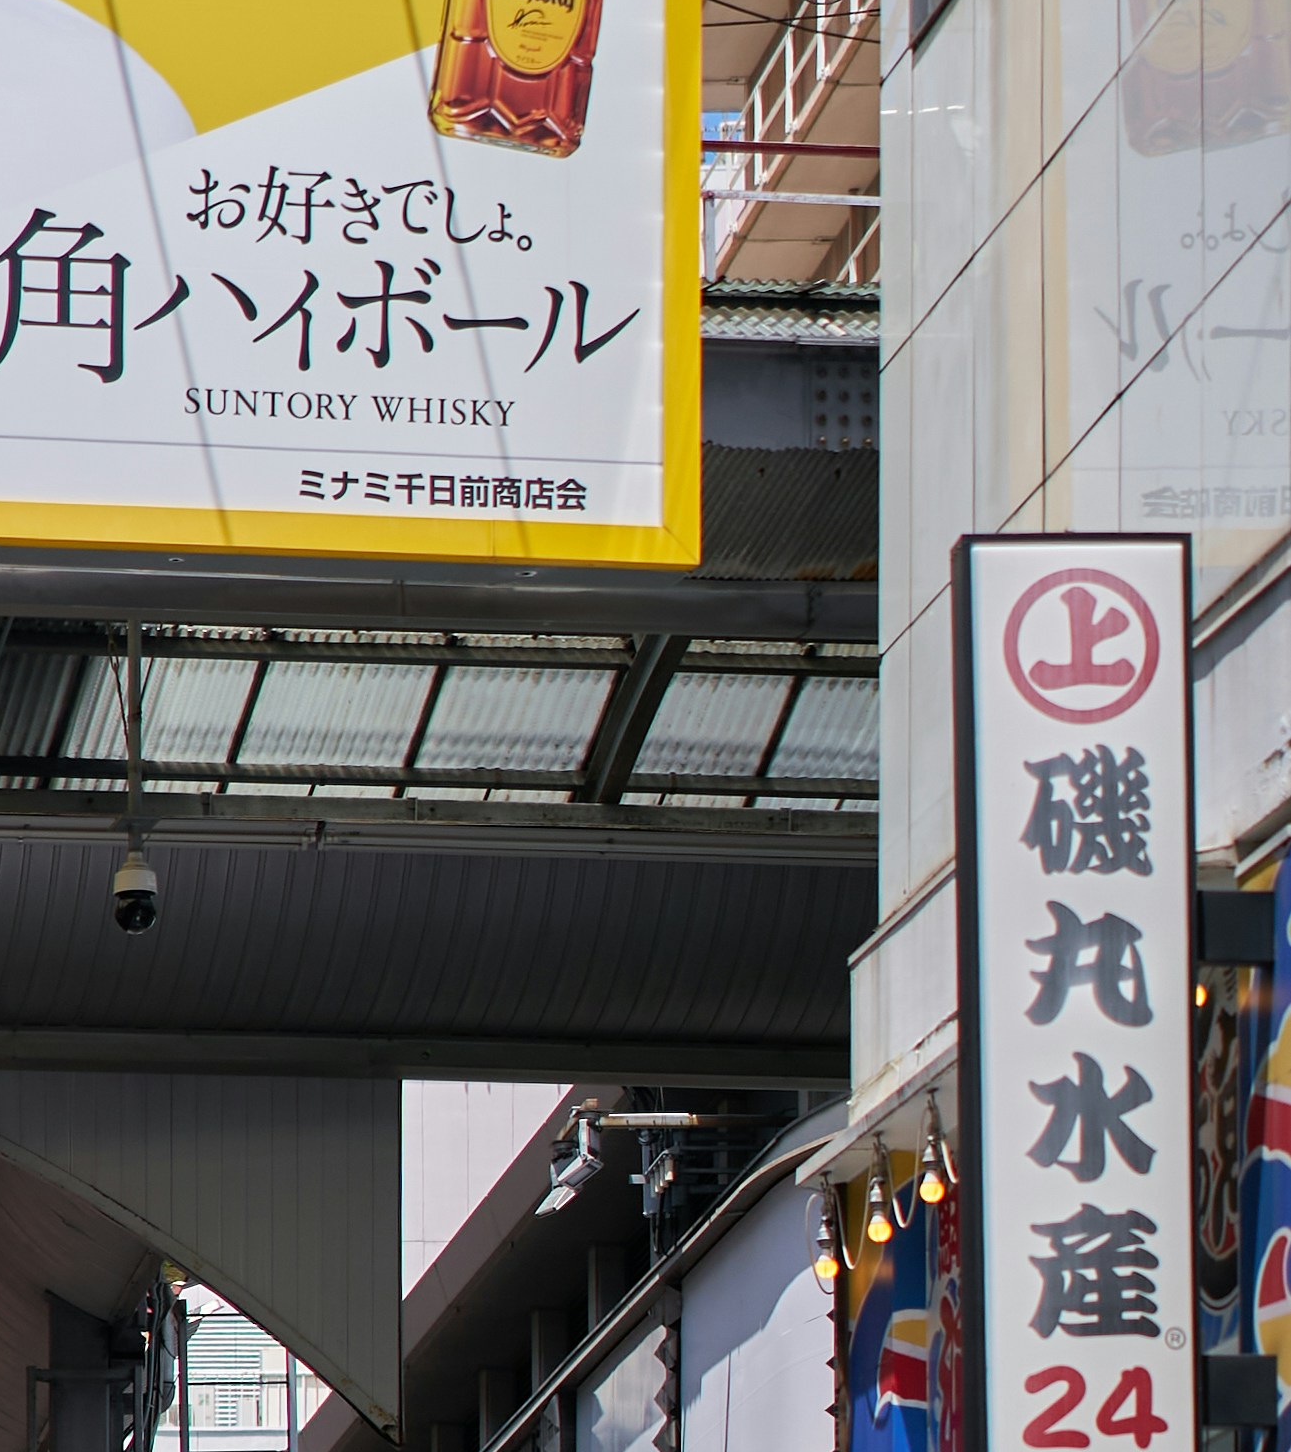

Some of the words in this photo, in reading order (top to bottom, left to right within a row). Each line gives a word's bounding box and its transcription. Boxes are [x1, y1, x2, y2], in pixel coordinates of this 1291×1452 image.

[185, 165, 536, 253] お好きでしょ。
[183, 386, 360, 423] SUNTORY
[373, 391, 516, 428] WHISKY
[297, 468, 589, 513] ミナミ千日前商店会
[1020, 743, 1162, 1340] 磯丸水産
[1021, 1365, 1169, 1451] 24
